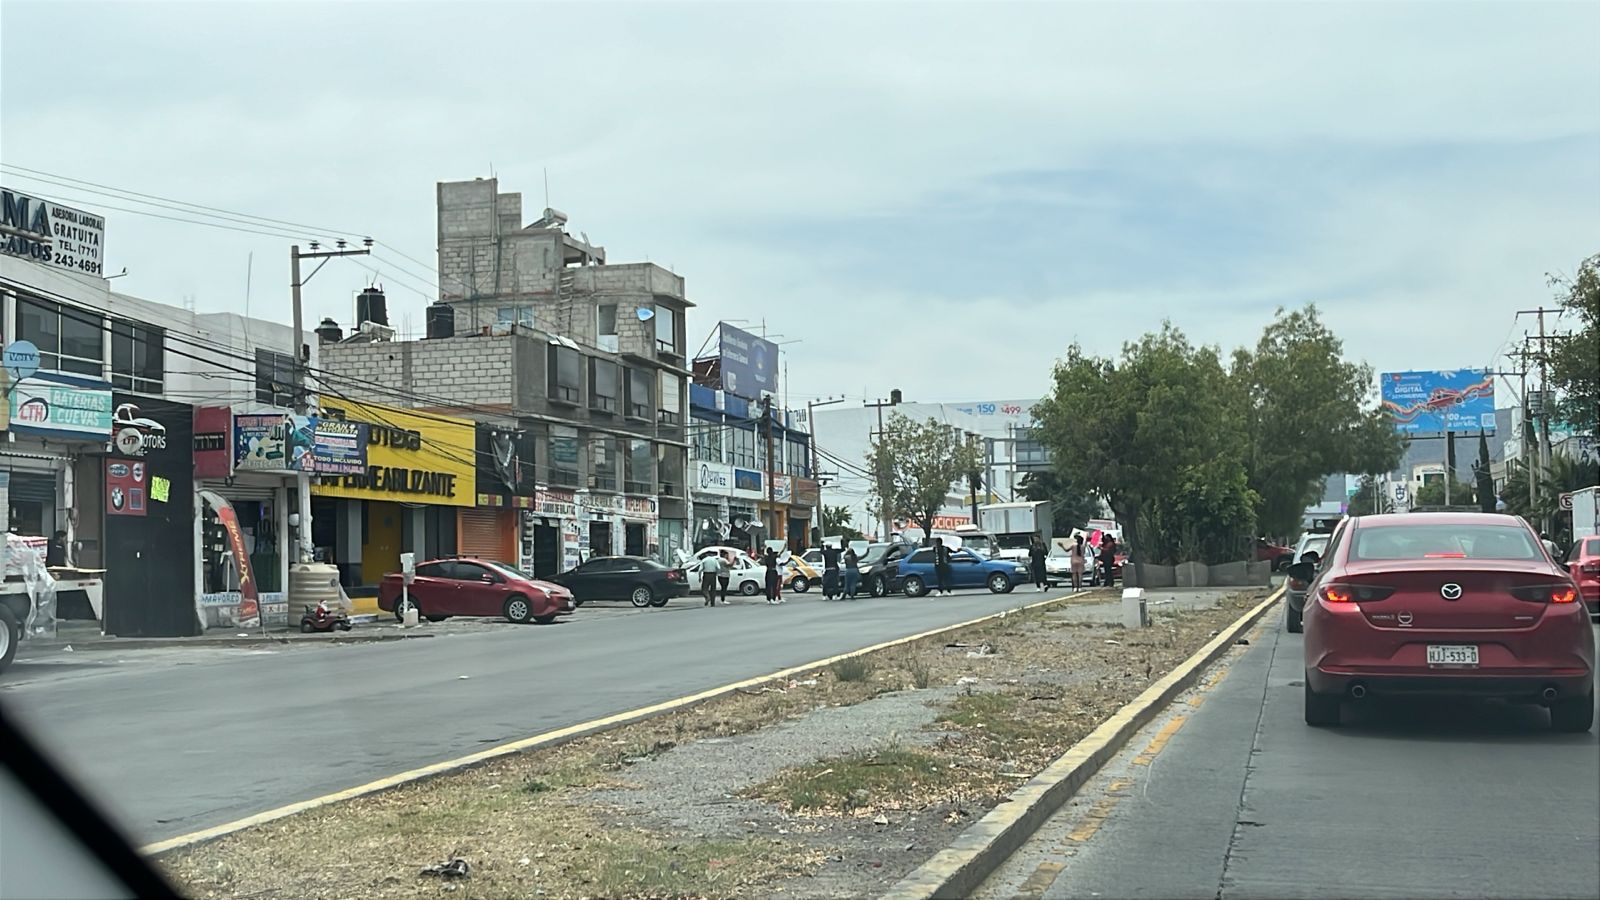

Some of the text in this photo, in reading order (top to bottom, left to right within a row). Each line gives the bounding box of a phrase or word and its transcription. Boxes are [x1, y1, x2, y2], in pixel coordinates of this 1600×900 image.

[79, 215, 103, 231] LABORAL
[54, 222, 99, 246] GRATUITA
[59, 240, 98, 259] TEL. (771)
[54, 253, 101, 274] 243-4691
[53, 390, 105, 410] BATERIAS
[976, 403, 996, 413] 150
[20, 404, 44, 422] LTH
[57, 409, 100, 427] CUEVAS
[315, 426, 359, 435] MAYORISTA
[322, 421, 349, 430] GRAN
[333, 457, 363, 465] INCLUIDO
